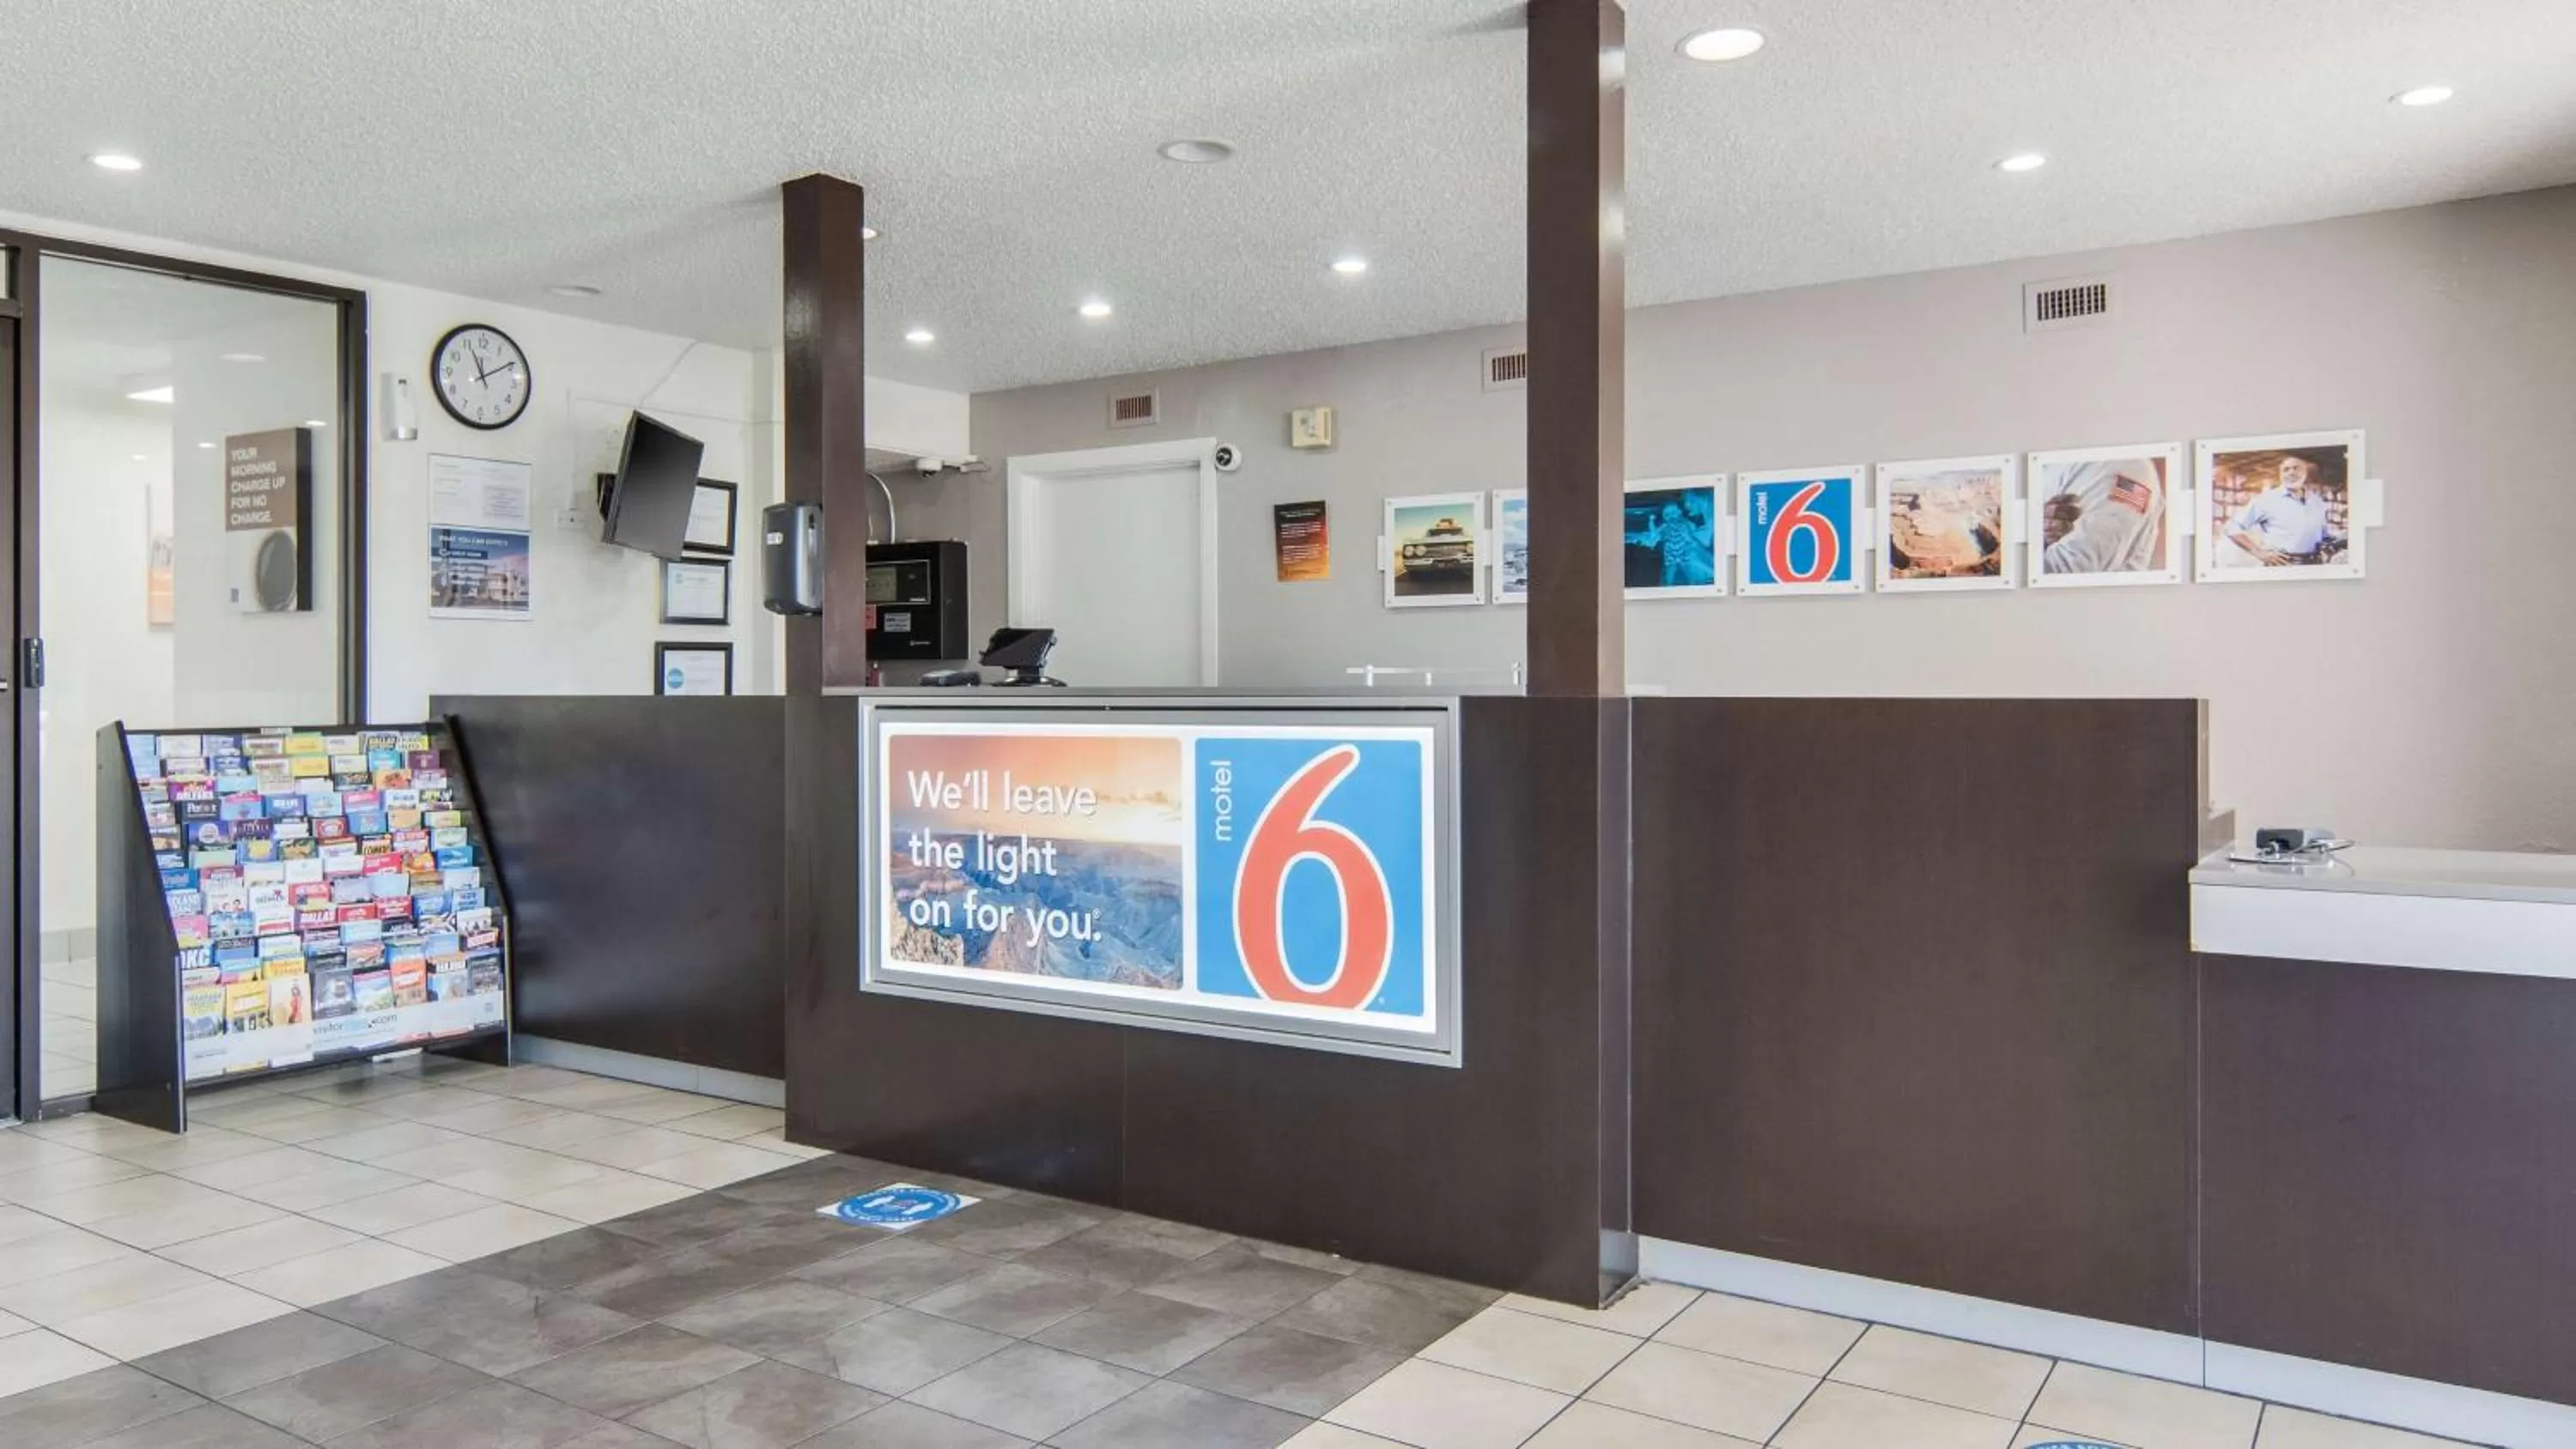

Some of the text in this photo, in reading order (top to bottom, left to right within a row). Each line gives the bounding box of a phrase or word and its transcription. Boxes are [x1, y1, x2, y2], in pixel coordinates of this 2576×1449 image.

[463, 339, 471, 352] 11
[478, 336, 489, 350] 12
[504, 393, 512, 403] 4
[231, 447, 258, 461] YOUR
[231, 461, 277, 477] MORNING
[231, 476, 286, 493] CHARGE UP
[231, 494, 267, 509] FOR NO
[1756, 482, 1839, 585] motel 6
[1003, 770, 1098, 815] leave
[908, 827, 1058, 885] the light
[1210, 743, 1394, 1011] motel 6
[909, 899, 951, 930] on
[963, 889, 1014, 933] for
